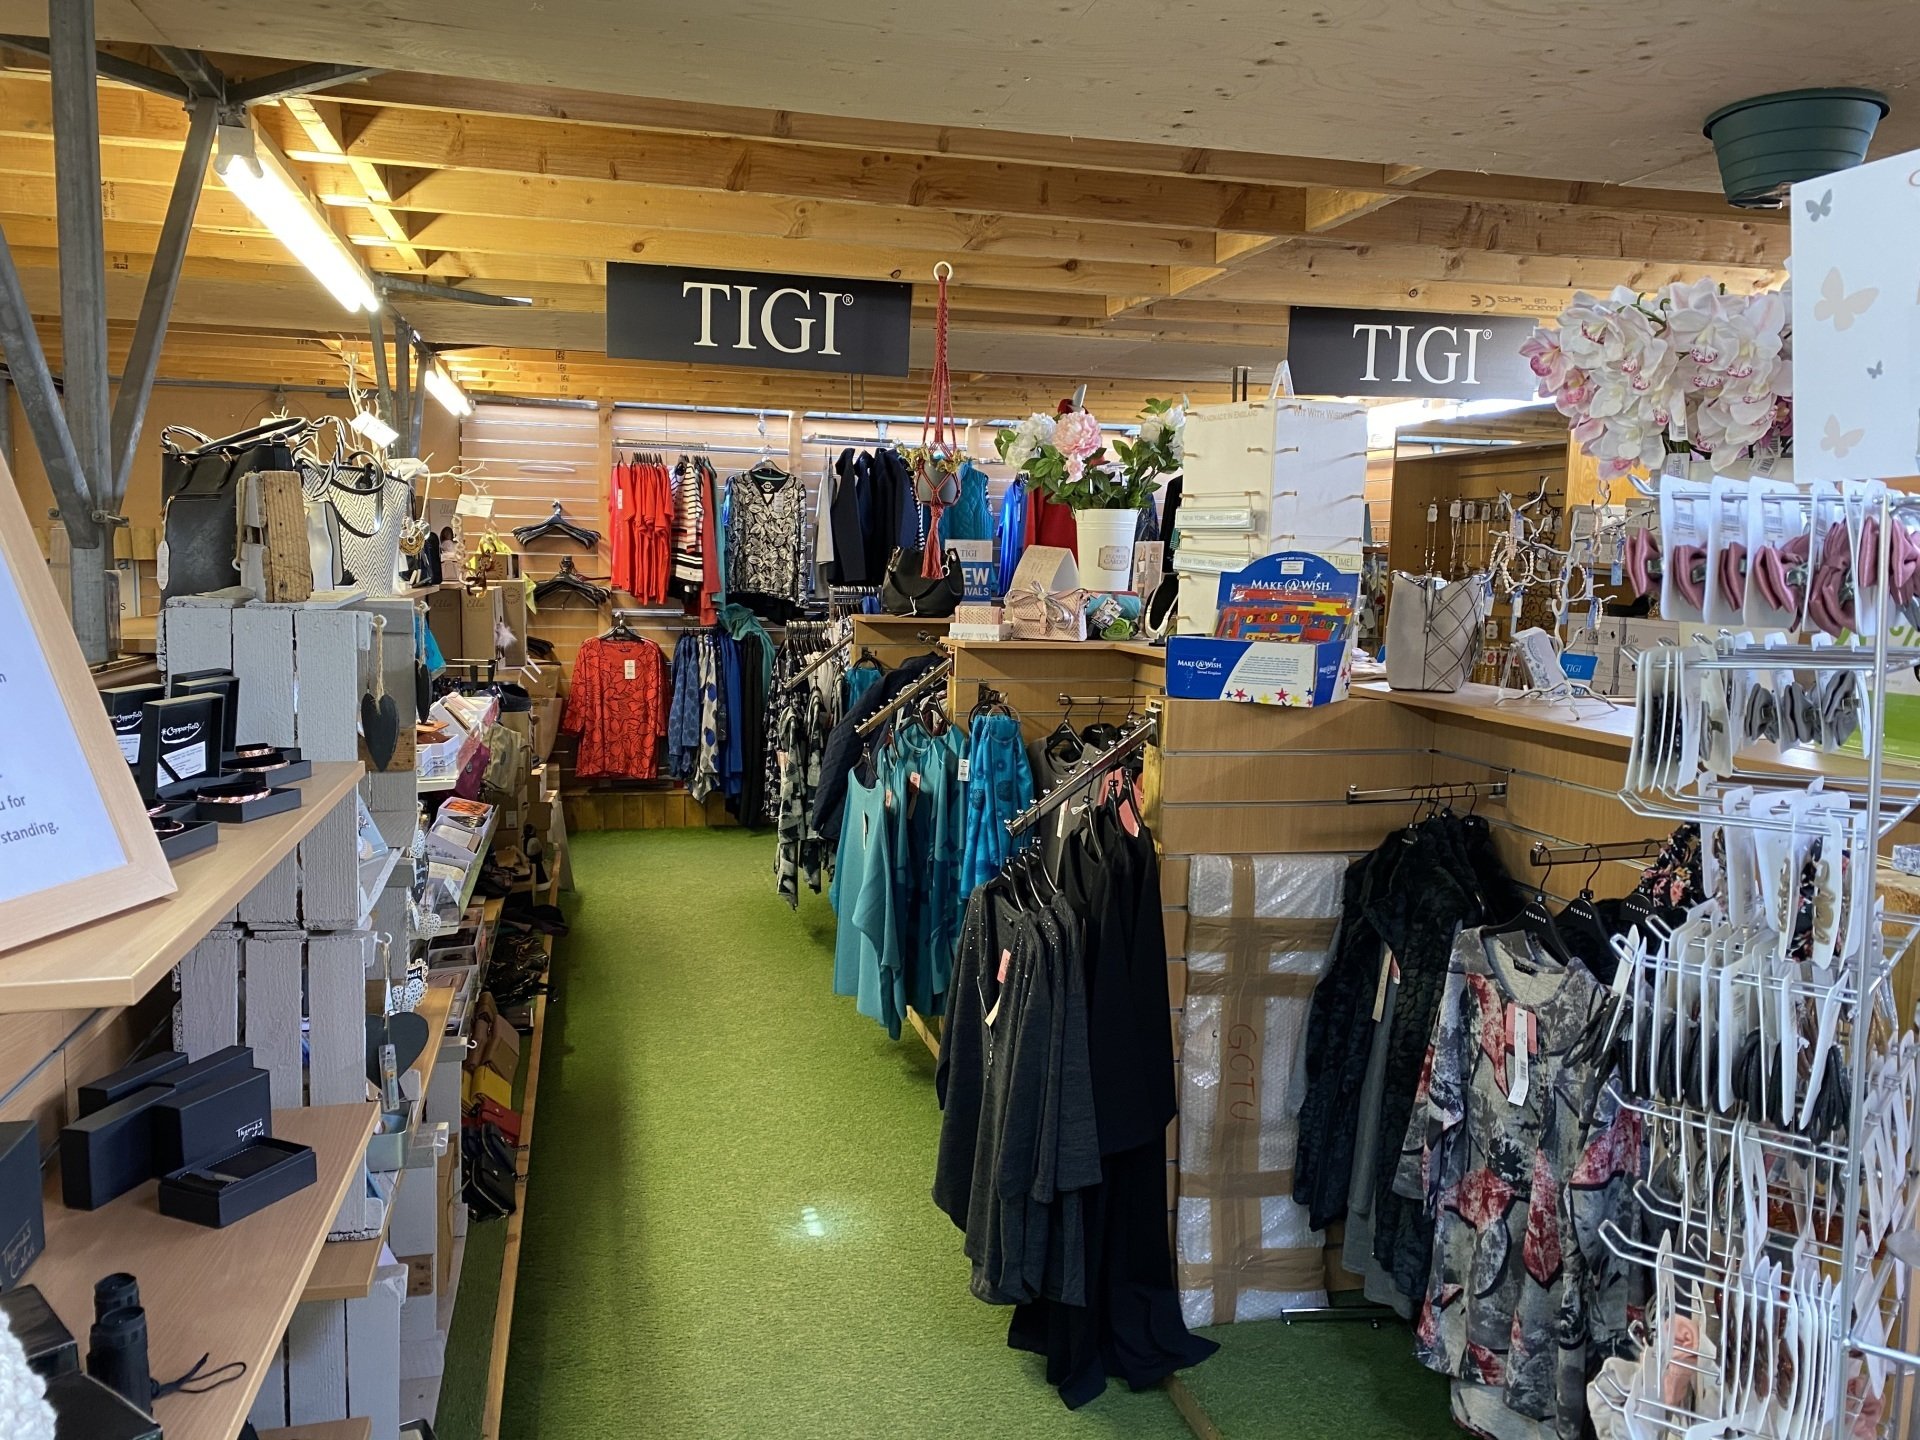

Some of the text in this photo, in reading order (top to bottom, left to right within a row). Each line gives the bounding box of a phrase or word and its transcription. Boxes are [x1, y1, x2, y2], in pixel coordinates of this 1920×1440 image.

[961, 567, 990, 586] EW
[964, 587, 990, 597] IVALS
[7, 795, 26, 808] for
[0, 820, 60, 845] standing.
